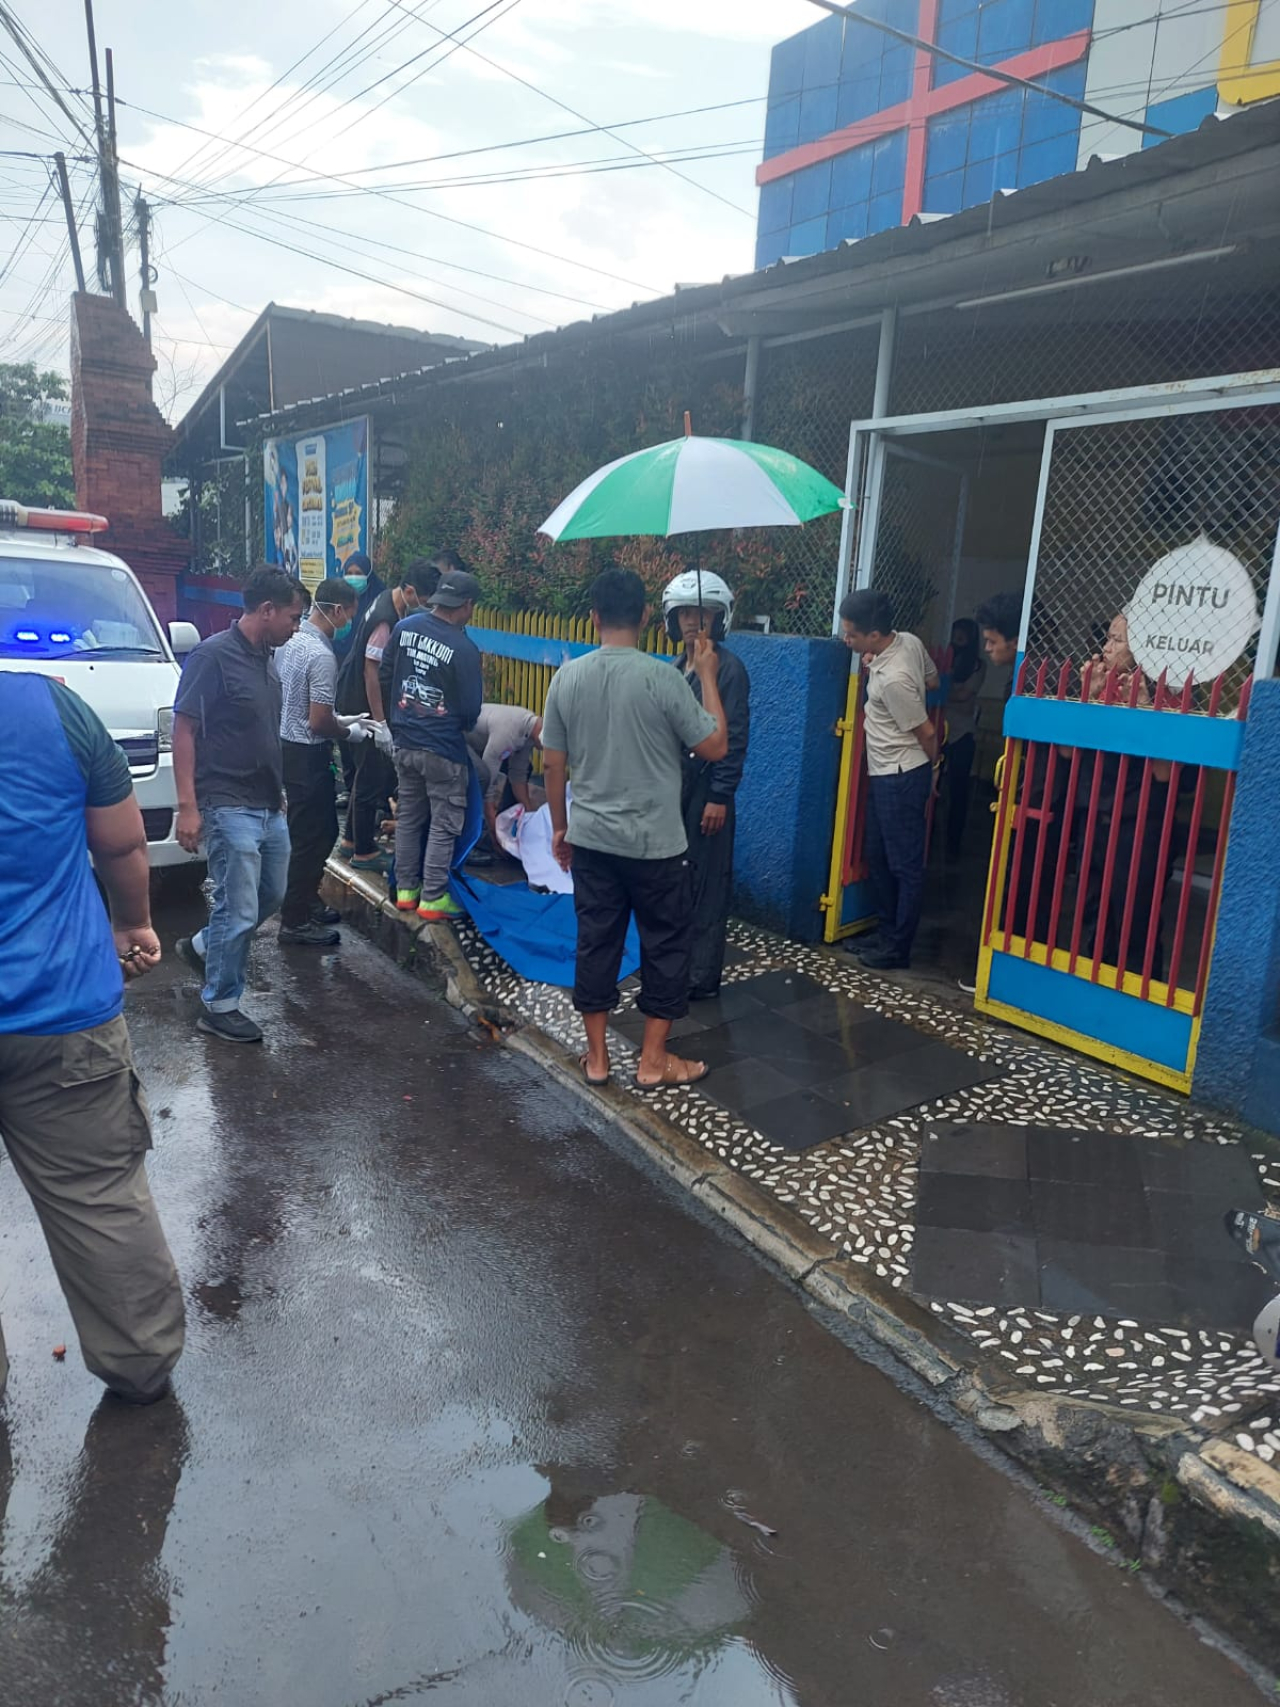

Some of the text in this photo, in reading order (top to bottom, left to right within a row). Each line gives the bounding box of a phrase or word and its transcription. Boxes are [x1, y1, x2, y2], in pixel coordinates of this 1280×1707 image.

[1151, 582, 1230, 609] PINTU
[400, 630, 419, 647] UNIT
[1145, 635, 1214, 655] KELUAR
